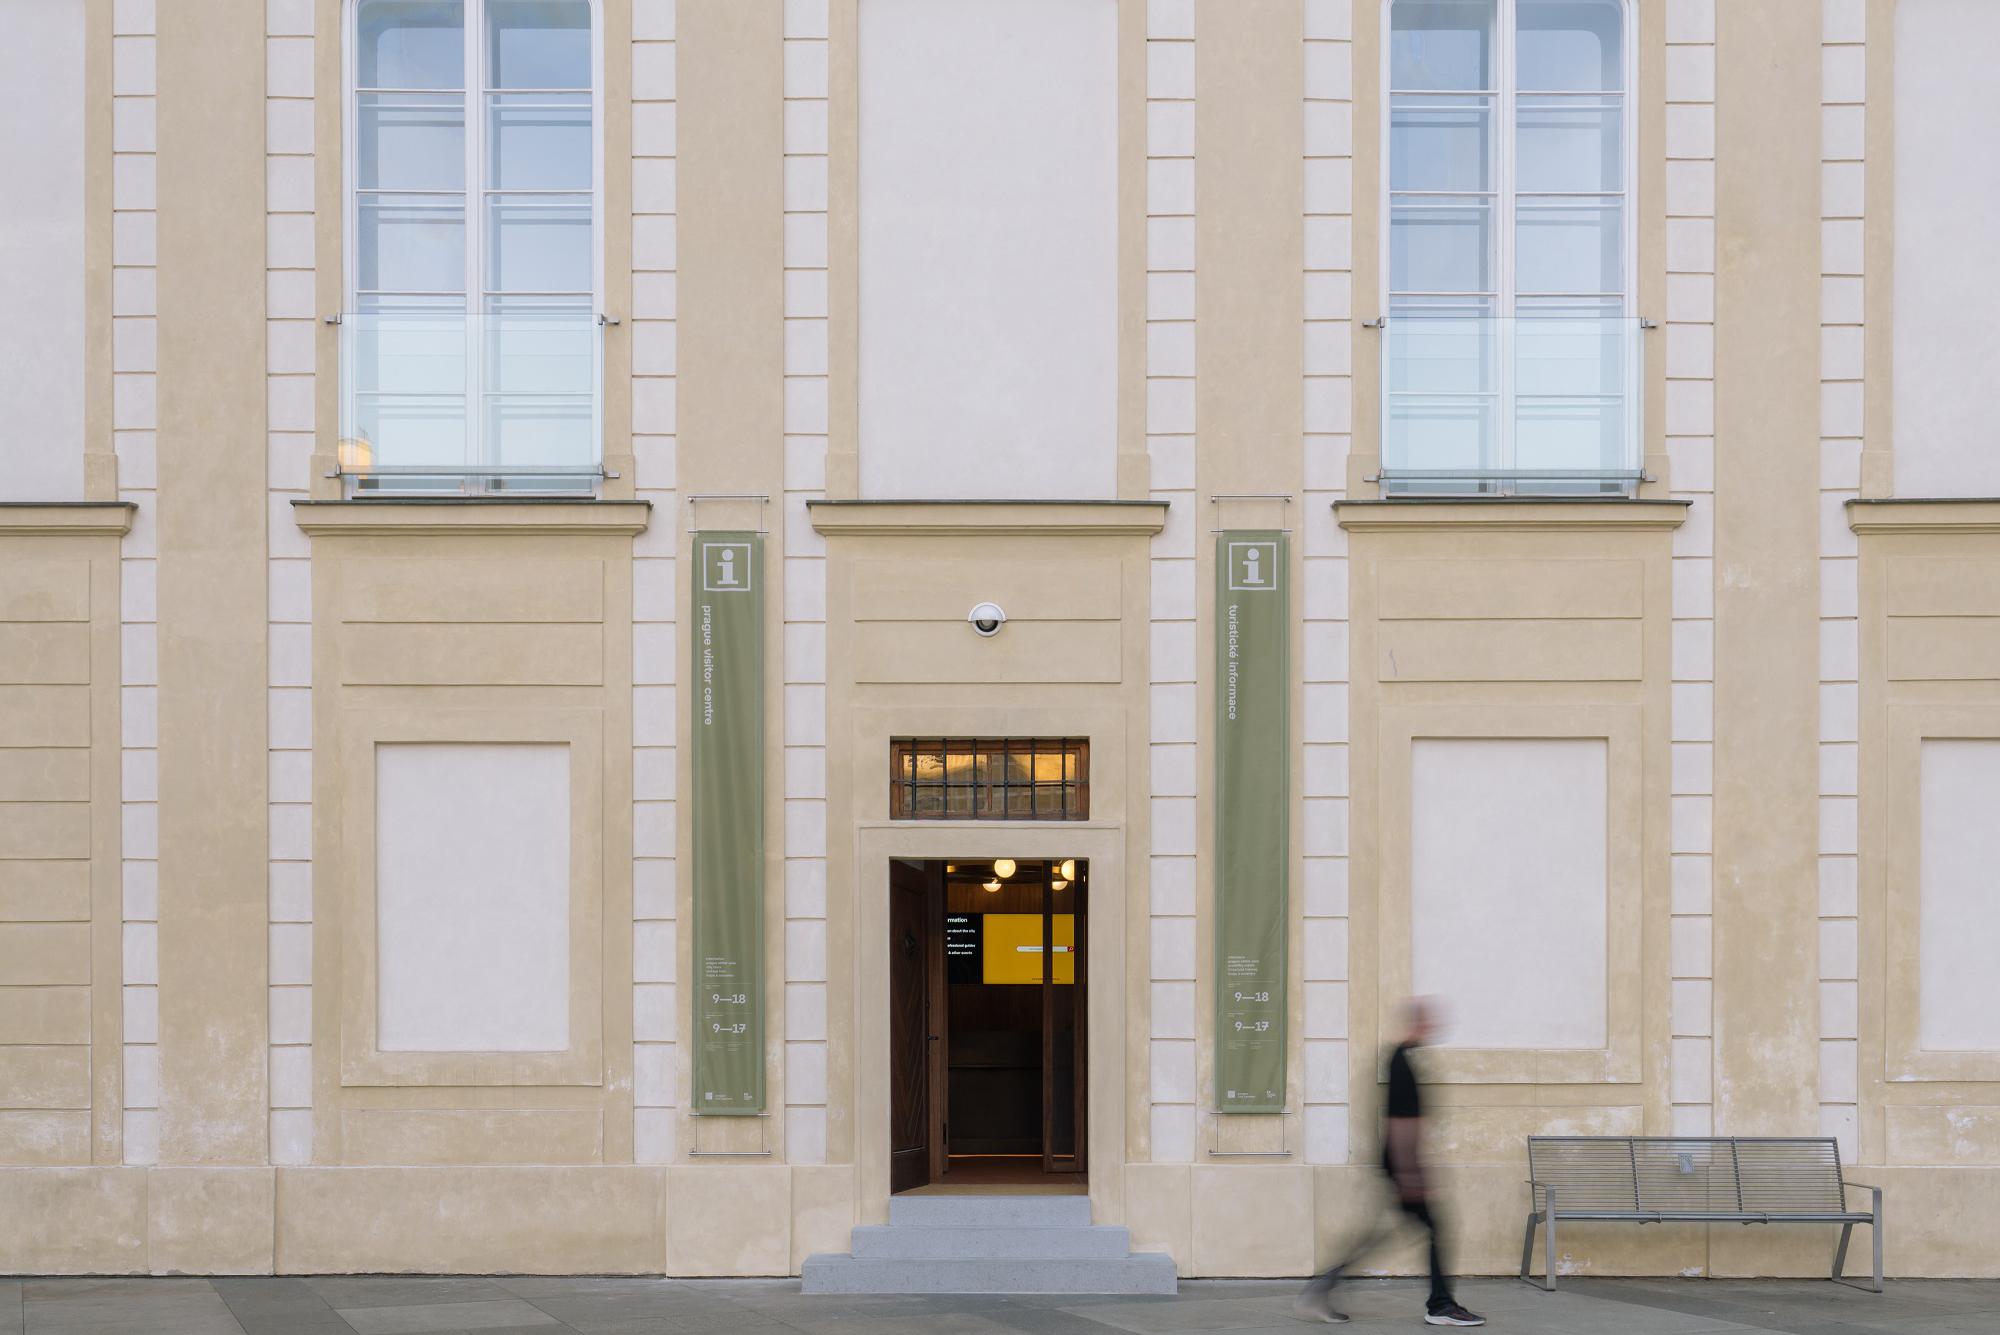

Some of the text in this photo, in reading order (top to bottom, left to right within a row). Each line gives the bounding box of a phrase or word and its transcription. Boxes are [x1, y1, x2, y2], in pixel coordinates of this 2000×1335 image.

[717, 549, 738, 585] i
[1243, 548, 1264, 584] i
[701, 605, 714, 725] prague visitor centre
[1229, 604, 1239, 720] turistické informace
